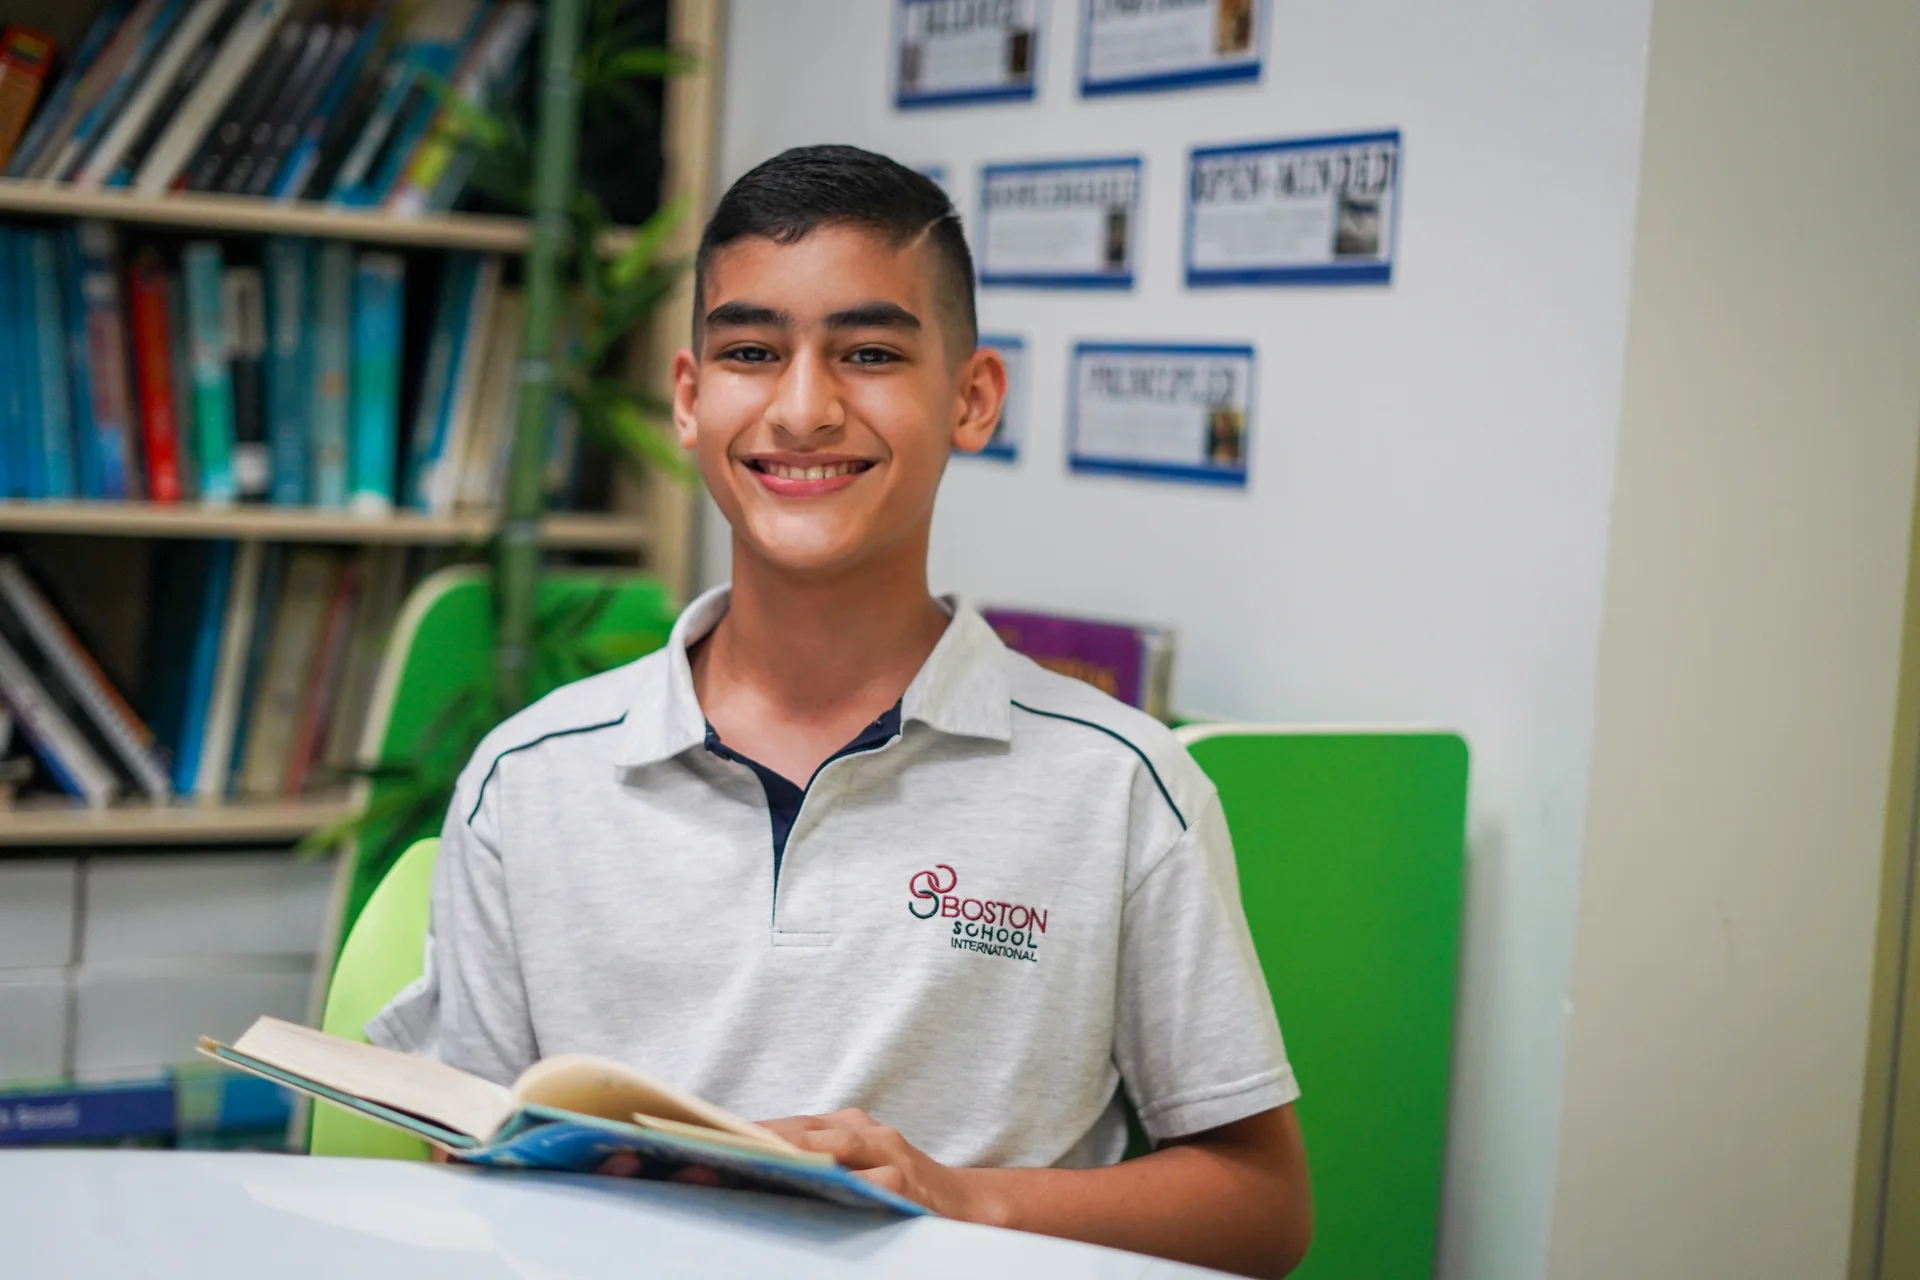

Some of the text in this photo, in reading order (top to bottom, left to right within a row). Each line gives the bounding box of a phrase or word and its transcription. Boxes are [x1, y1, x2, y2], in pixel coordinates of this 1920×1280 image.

[941, 895, 1048, 934] BOSTON
[952, 920, 1038, 949] SCHOOL
[951, 936, 1038, 963] INTERNATIONAL
